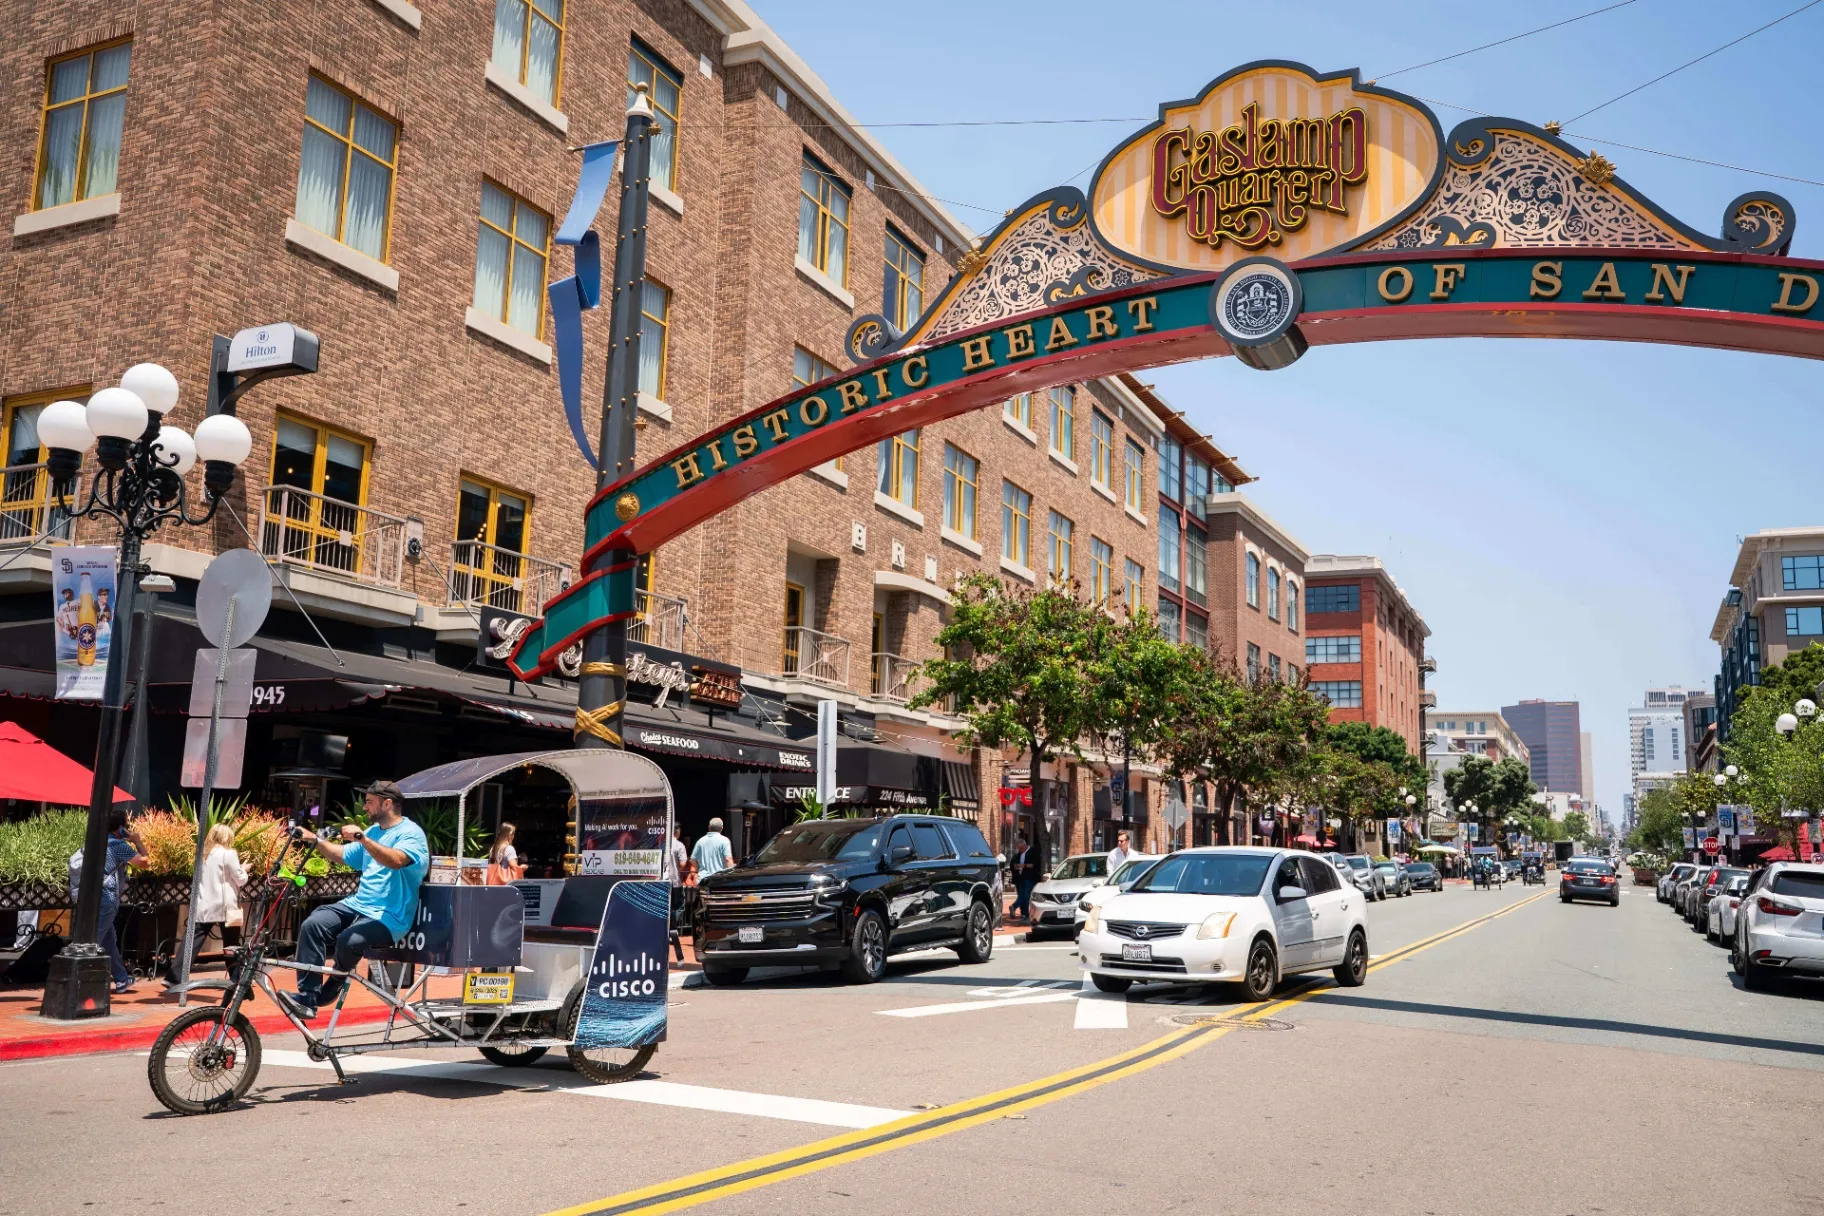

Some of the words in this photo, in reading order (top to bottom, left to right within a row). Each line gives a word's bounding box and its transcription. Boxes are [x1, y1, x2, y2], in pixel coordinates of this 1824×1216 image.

[1151, 102, 1368, 215] Gaslamp
[1186, 168, 1338, 248] Quarter
[246, 345, 277, 358] Hilton
[670, 355, 929, 489] HISTORIC
[959, 297, 1158, 371] HEART
[1377, 263, 1466, 301] OF
[1530, 261, 1697, 303] SAN
[640, 731, 662, 745] Choice
[661, 735, 699, 749] SEAFOOD
[779, 752, 808, 762] EXOTIC
[780, 758, 811, 767] DRINKS
[785, 787, 851, 799] ENTRCE
[906, 794, 927, 804] Avenue
[584, 824, 601, 832] Making
[648, 827, 665, 835] CISCO
[599, 979, 655, 998] CISCO
